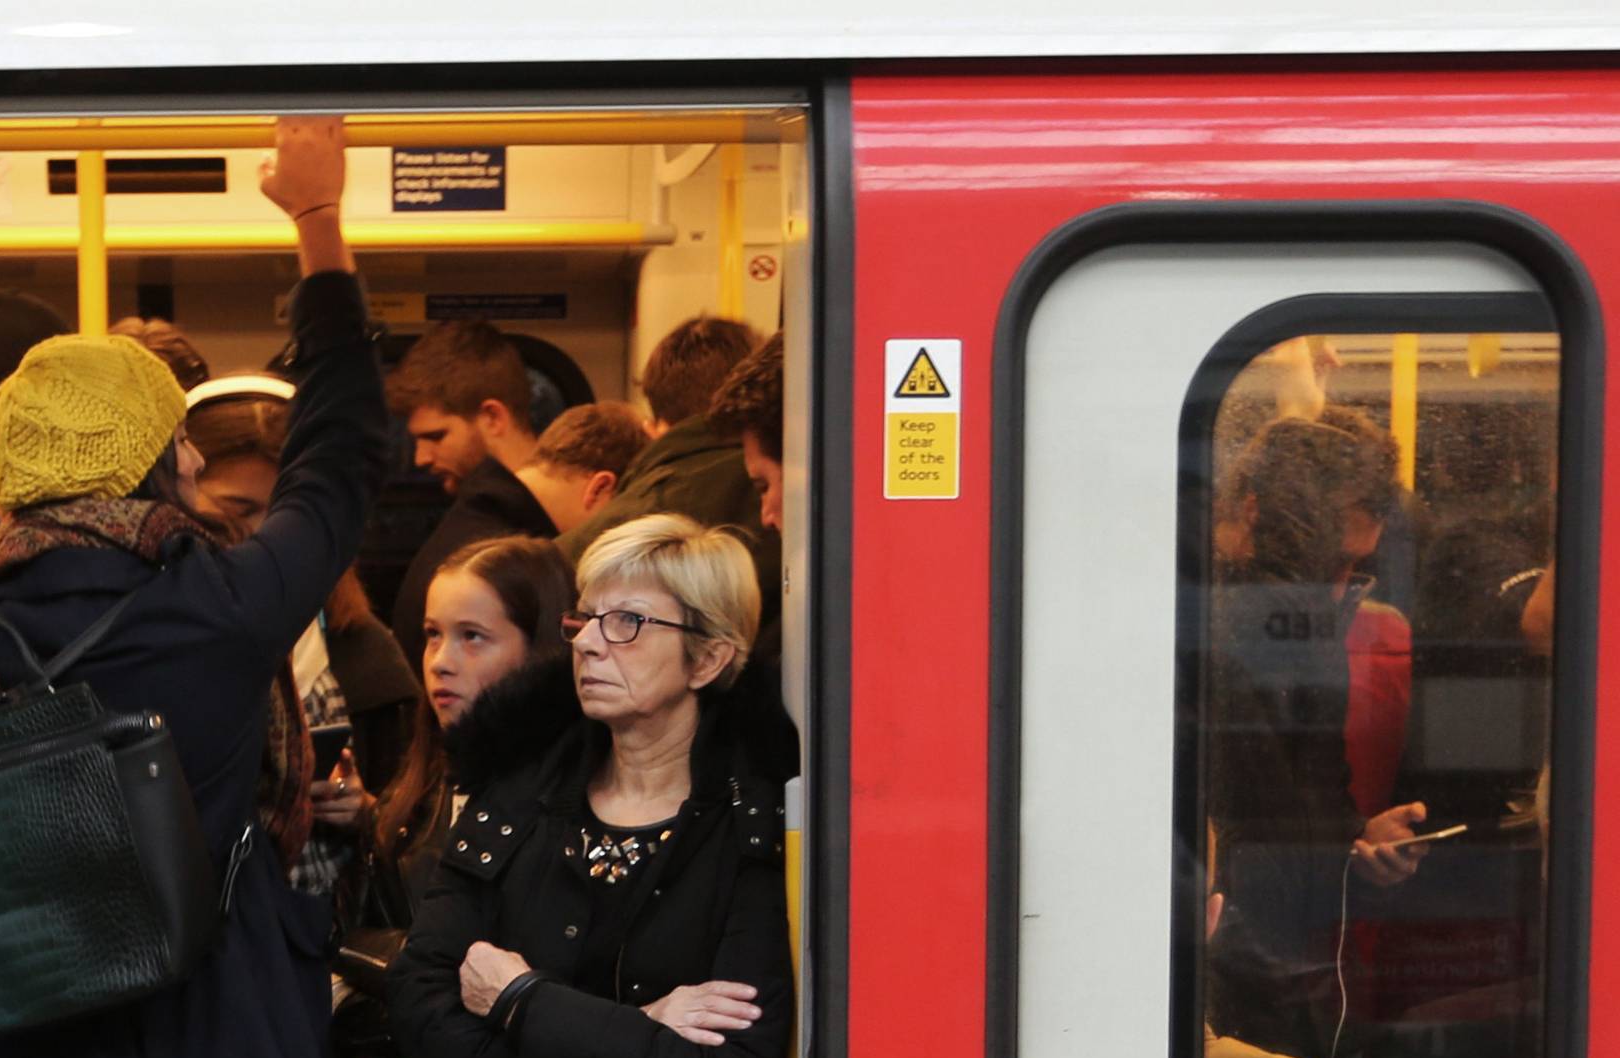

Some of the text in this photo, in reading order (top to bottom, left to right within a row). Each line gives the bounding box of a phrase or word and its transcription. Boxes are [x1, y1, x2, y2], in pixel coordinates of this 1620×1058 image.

[394, 151, 490, 164] Please listen for
[394, 166, 502, 177] announcements or
[394, 178, 500, 190] check information
[394, 191, 444, 204] displays
[899, 419, 936, 434] Keep
[899, 436, 934, 448] clear
[898, 452, 945, 464] of the
[898, 469, 940, 481] doors
